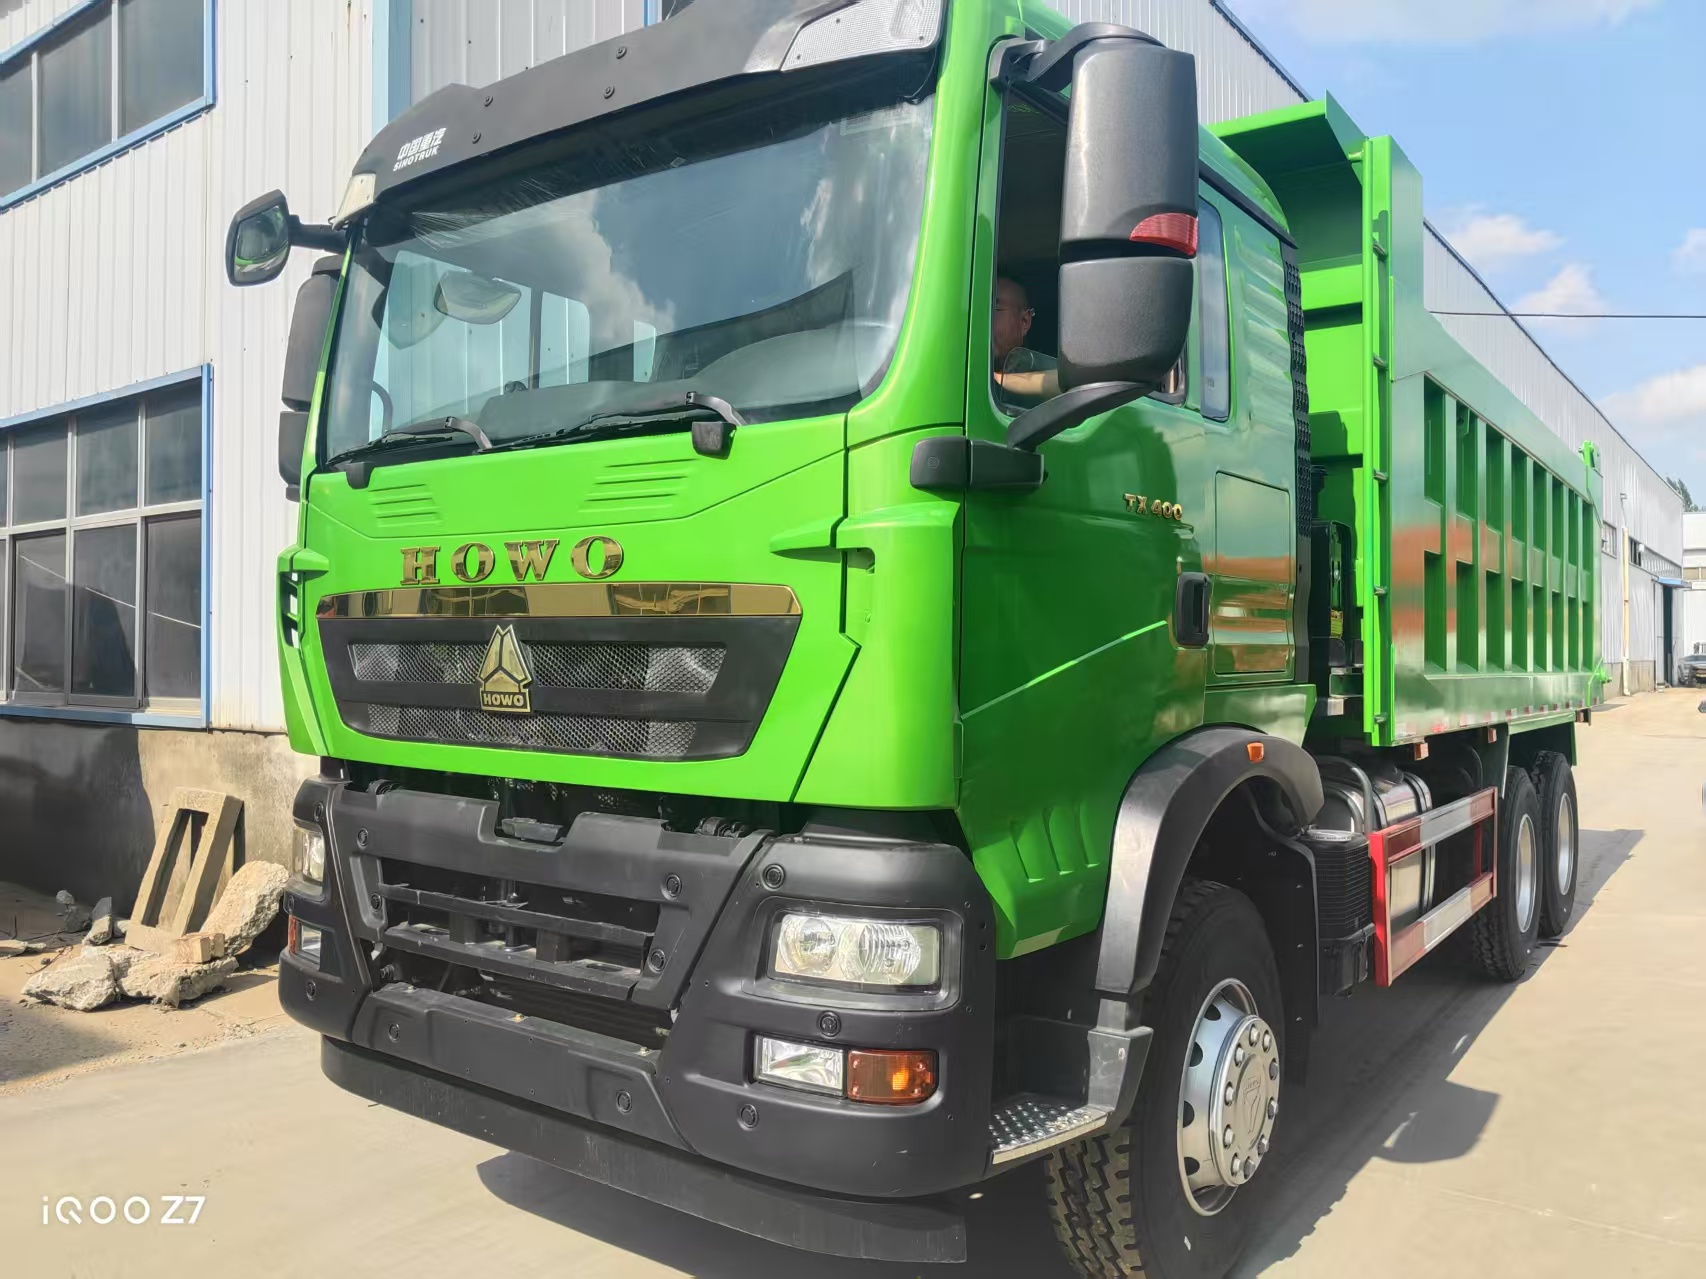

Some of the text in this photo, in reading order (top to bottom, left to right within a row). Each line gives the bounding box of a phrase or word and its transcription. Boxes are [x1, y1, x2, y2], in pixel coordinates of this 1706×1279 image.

[392, 145, 440, 172] SINOTRUK
[1123, 493, 1183, 521] TX 400
[400, 535, 624, 585] HOWO
[483, 693, 524, 707] HOWO
